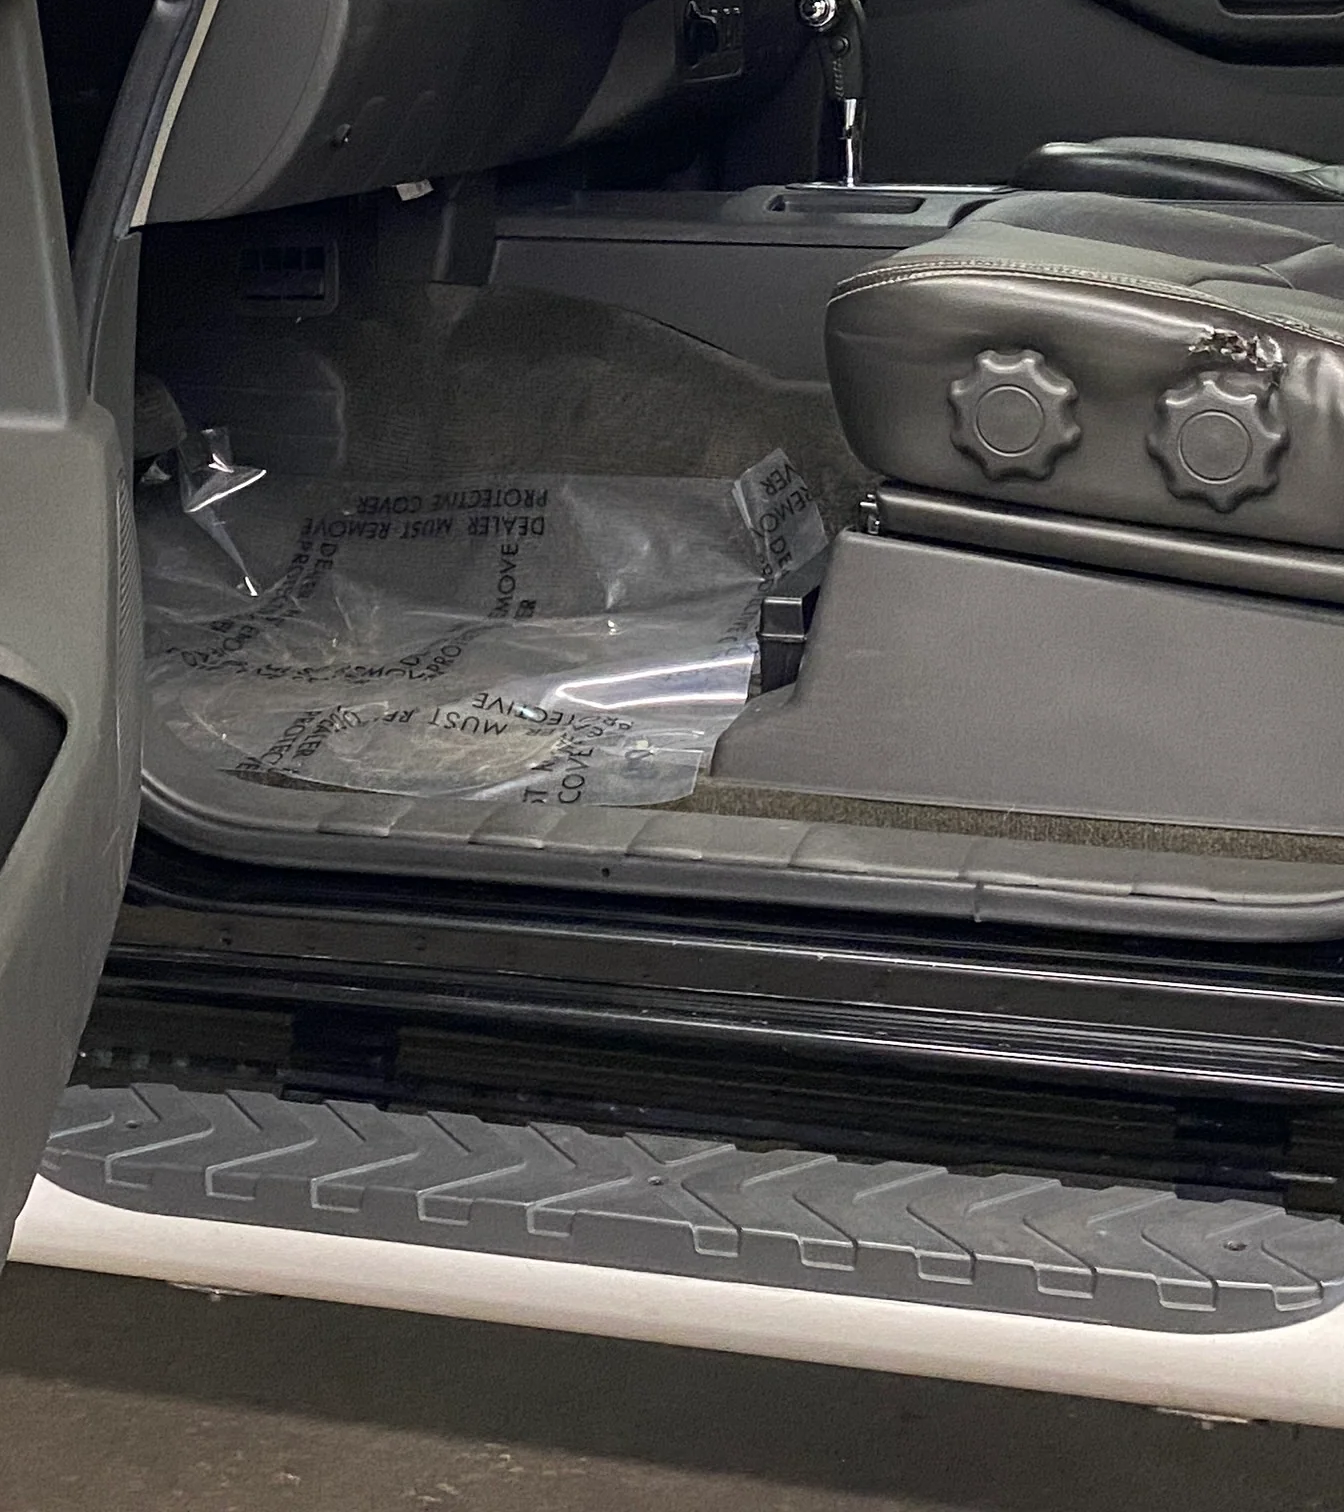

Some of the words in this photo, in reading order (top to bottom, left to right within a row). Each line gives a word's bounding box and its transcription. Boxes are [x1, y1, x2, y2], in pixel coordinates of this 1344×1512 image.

[759, 463, 798, 497] VER
[355, 495, 423, 515] COVER
[432, 488, 549, 511] PROTECTIVE
[300, 517, 392, 540] REMOVE
[399, 517, 454, 540] MUST
[467, 514, 546, 536] DEALER
[488, 543, 519, 619] EMOVE
[427, 707, 508, 736] MUST
